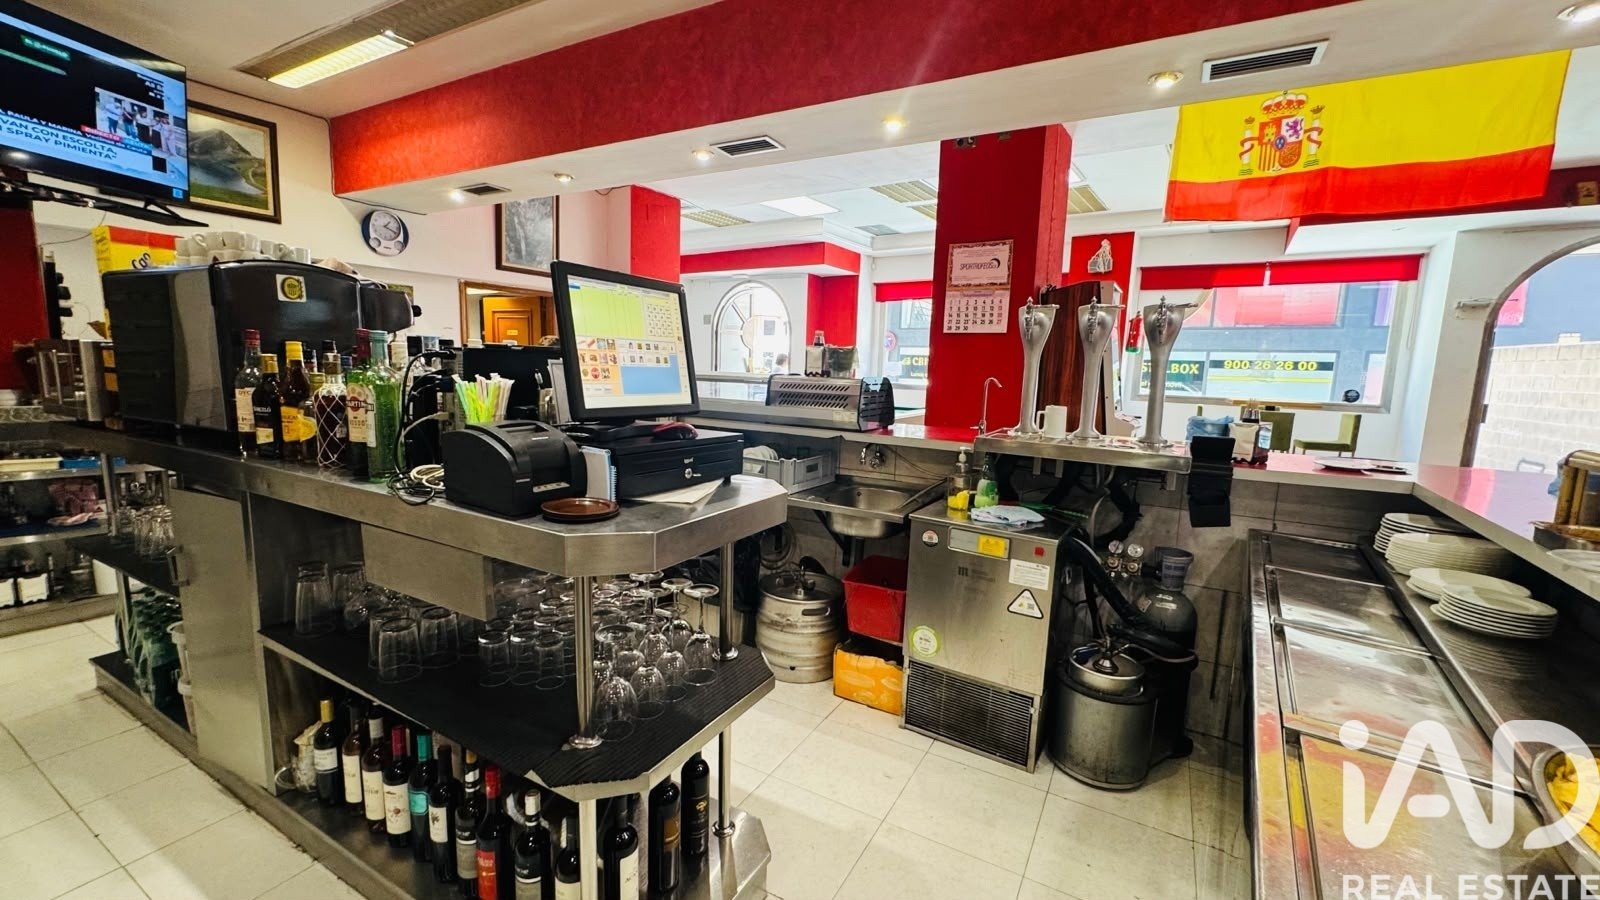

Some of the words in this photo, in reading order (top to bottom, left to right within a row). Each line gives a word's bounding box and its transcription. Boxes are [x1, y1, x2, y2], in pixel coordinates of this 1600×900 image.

[6, 127, 51, 143] SPRAY
[31, 127, 59, 138] CON
[1224, 360, 1250, 369] 900
[1255, 360, 1271, 370] 26
[1275, 361, 1294, 371] 26
[1298, 361, 1318, 371] 00
